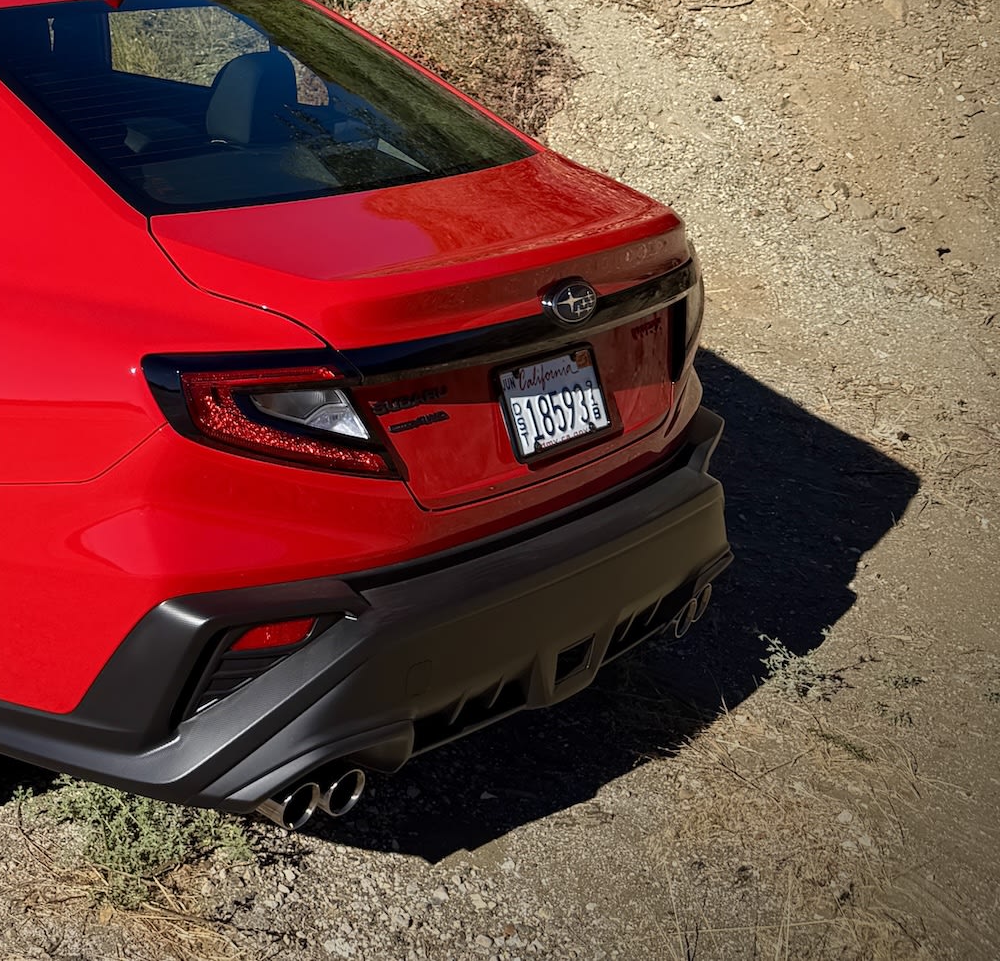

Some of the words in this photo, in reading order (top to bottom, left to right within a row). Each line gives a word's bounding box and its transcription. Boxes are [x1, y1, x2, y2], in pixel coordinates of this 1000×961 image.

[519, 360, 577, 391] California
[512, 402, 529, 446] DST
[525, 384, 590, 441] 18593
